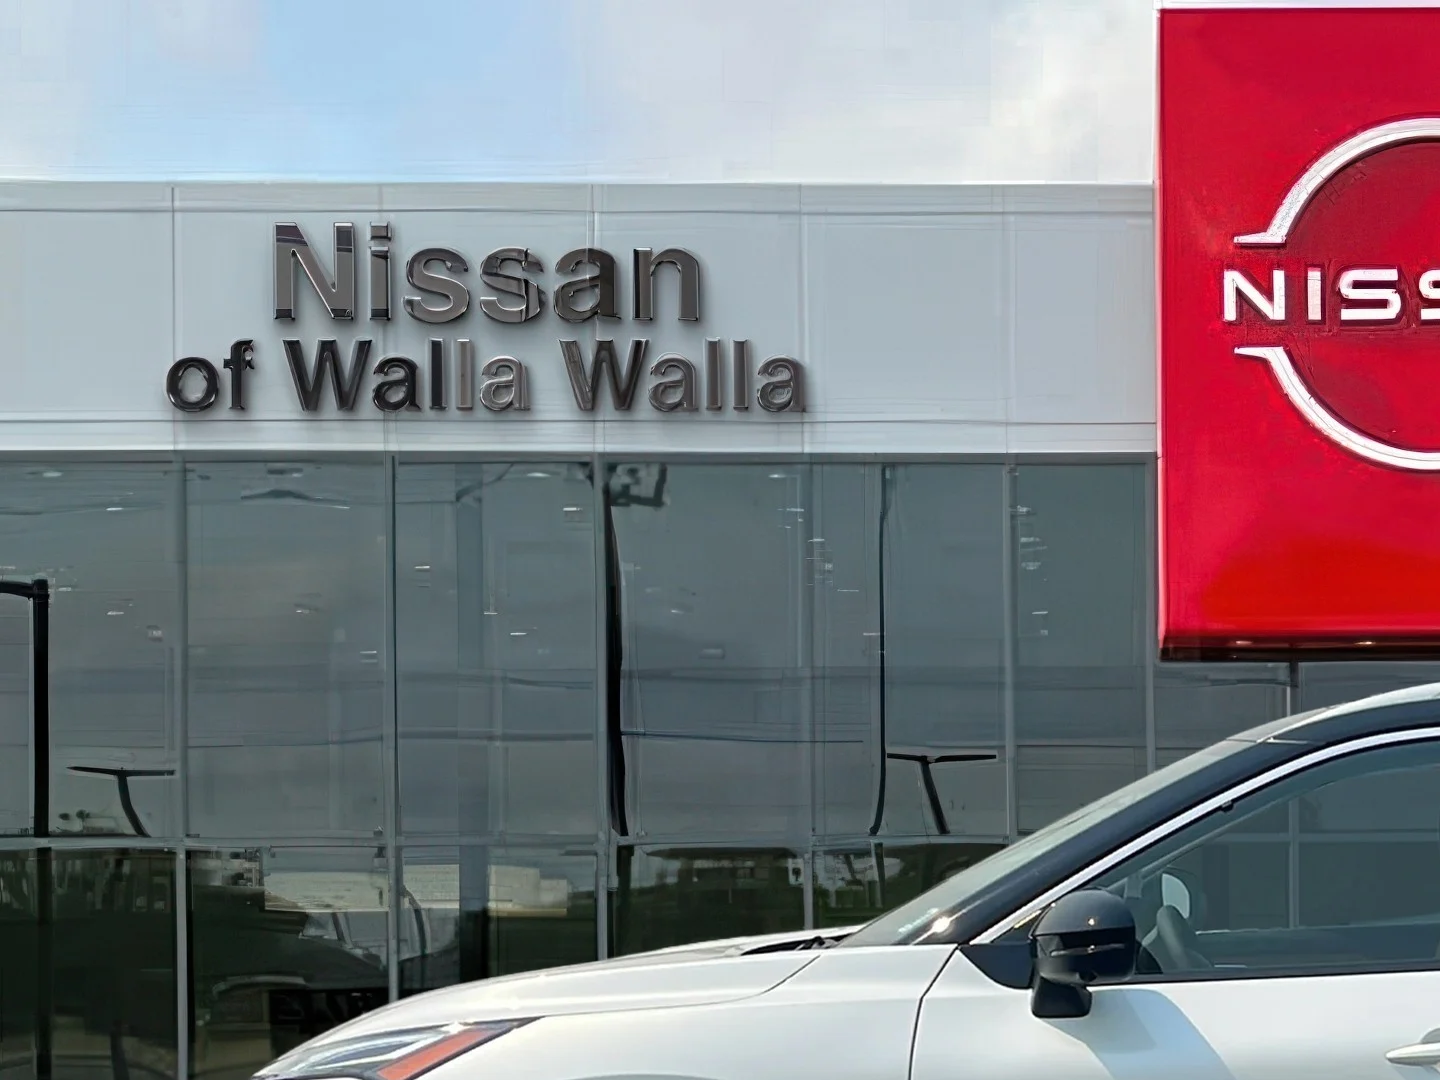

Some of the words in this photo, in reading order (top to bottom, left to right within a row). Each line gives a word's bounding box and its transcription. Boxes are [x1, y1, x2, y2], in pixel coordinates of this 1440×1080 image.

[273, 221, 702, 322] Nissan
[166, 338, 254, 412] of
[281, 338, 531, 412] Walla
[557, 338, 807, 412] Walla
